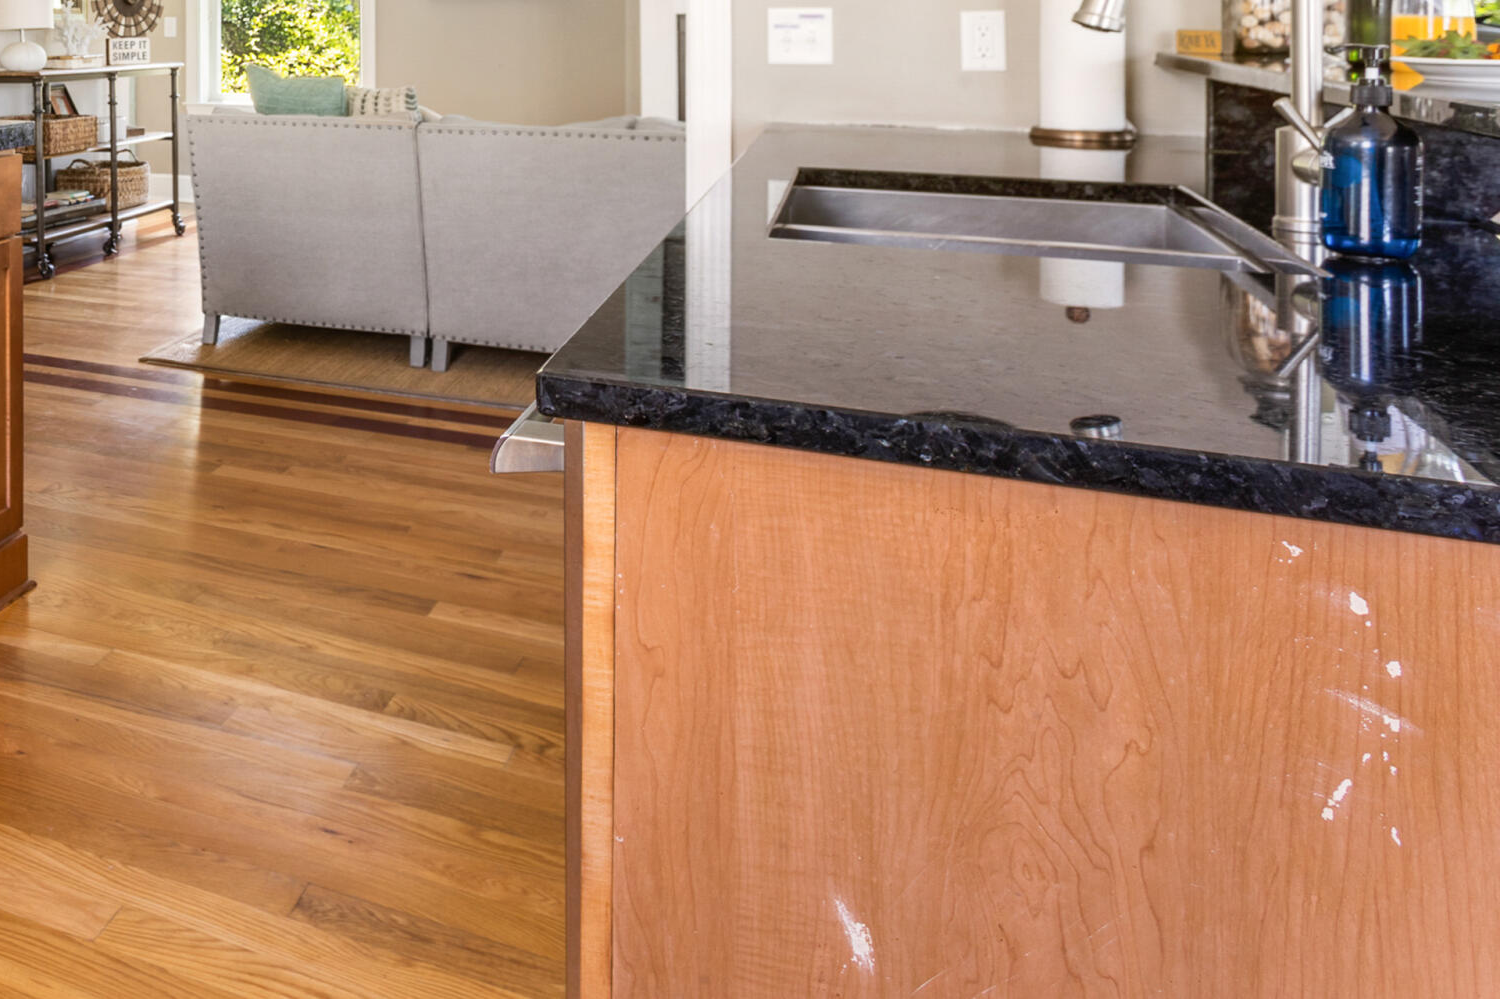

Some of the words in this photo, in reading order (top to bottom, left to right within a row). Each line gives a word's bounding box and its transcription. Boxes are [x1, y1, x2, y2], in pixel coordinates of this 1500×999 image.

[112, 40, 136, 50] KEEP
[138, 40, 148, 49] IT
[112, 51, 148, 61] SIMPLE
